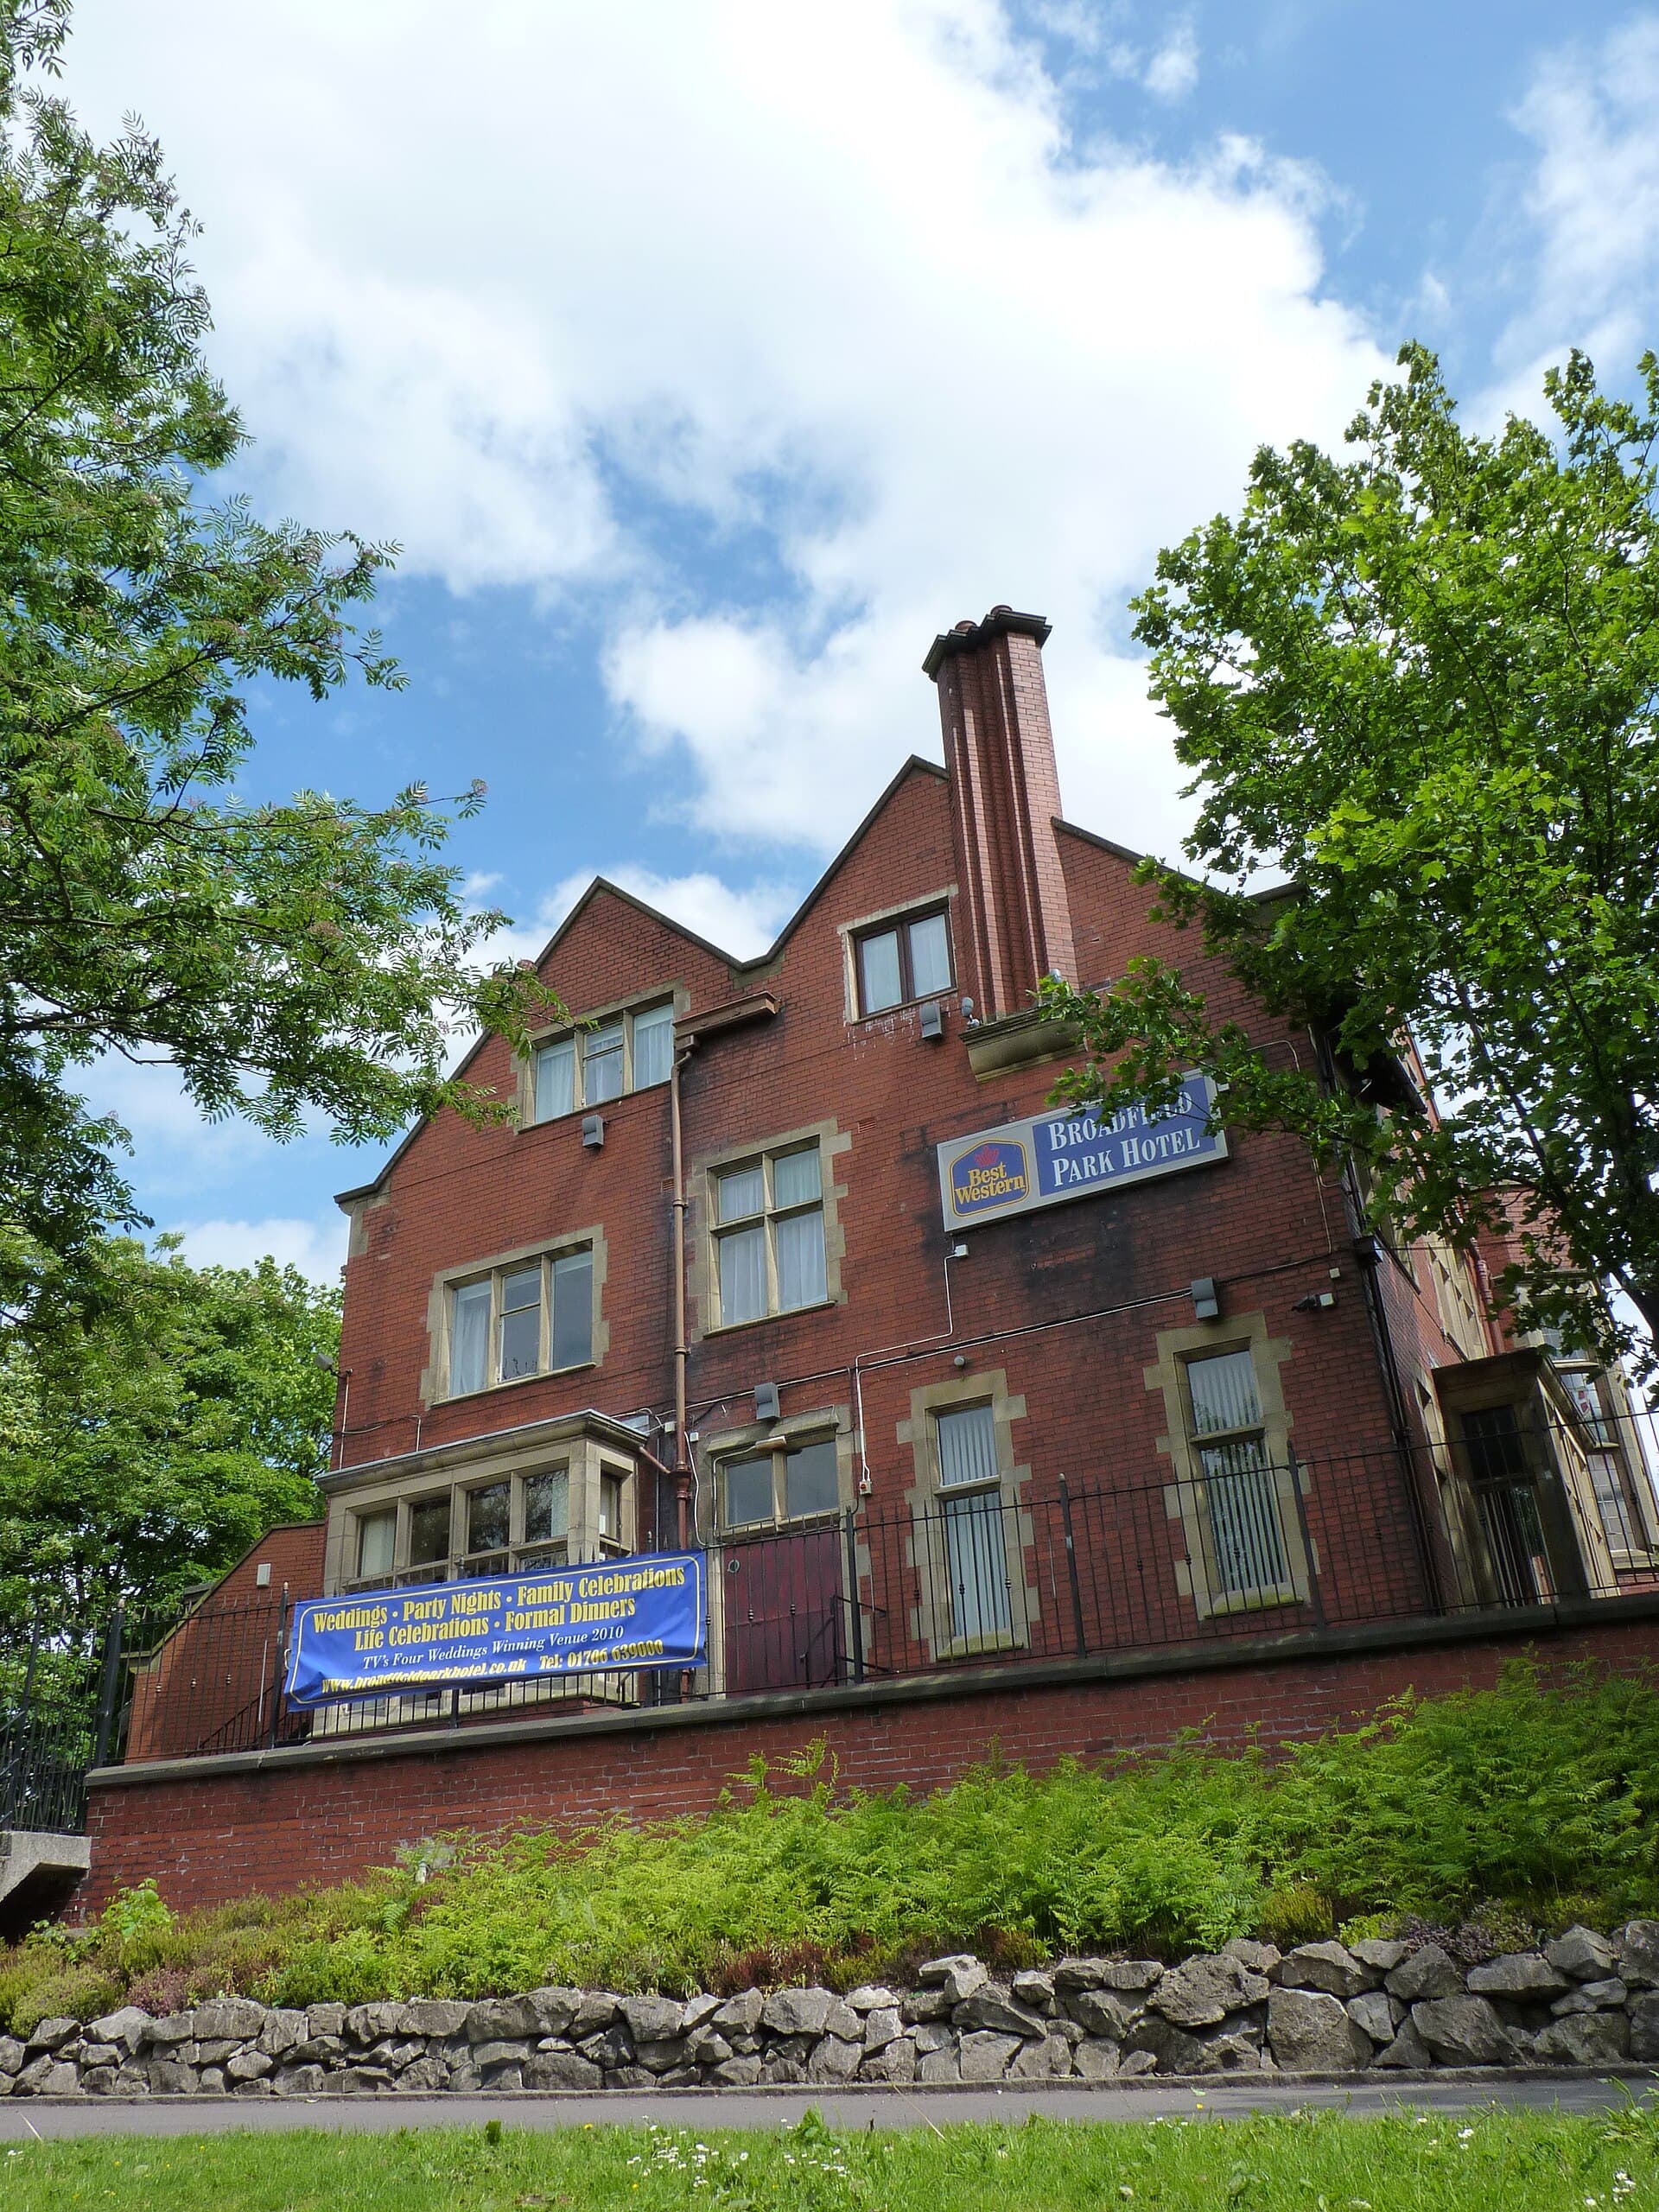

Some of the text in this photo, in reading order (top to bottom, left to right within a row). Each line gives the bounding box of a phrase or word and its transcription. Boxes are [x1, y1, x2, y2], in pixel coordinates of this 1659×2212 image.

[967, 1161, 1007, 1187] Best
[1052, 1128, 1200, 1187] PARK HOTEL
[954, 1174, 1025, 1205] Western
[313, 1567, 685, 1632] Weddings Party Nights Family Celebrations
[354, 1597, 636, 1651] Life Celebrations Formal Dinners
[392, 1652, 424, 1667] Four
[428, 1644, 487, 1662] Weddings
[492, 1636, 545, 1654] Winning
[550, 1632, 588, 1647] Venue
[592, 1624, 624, 1641] 2010
[539, 1654, 563, 1670] Tel:
